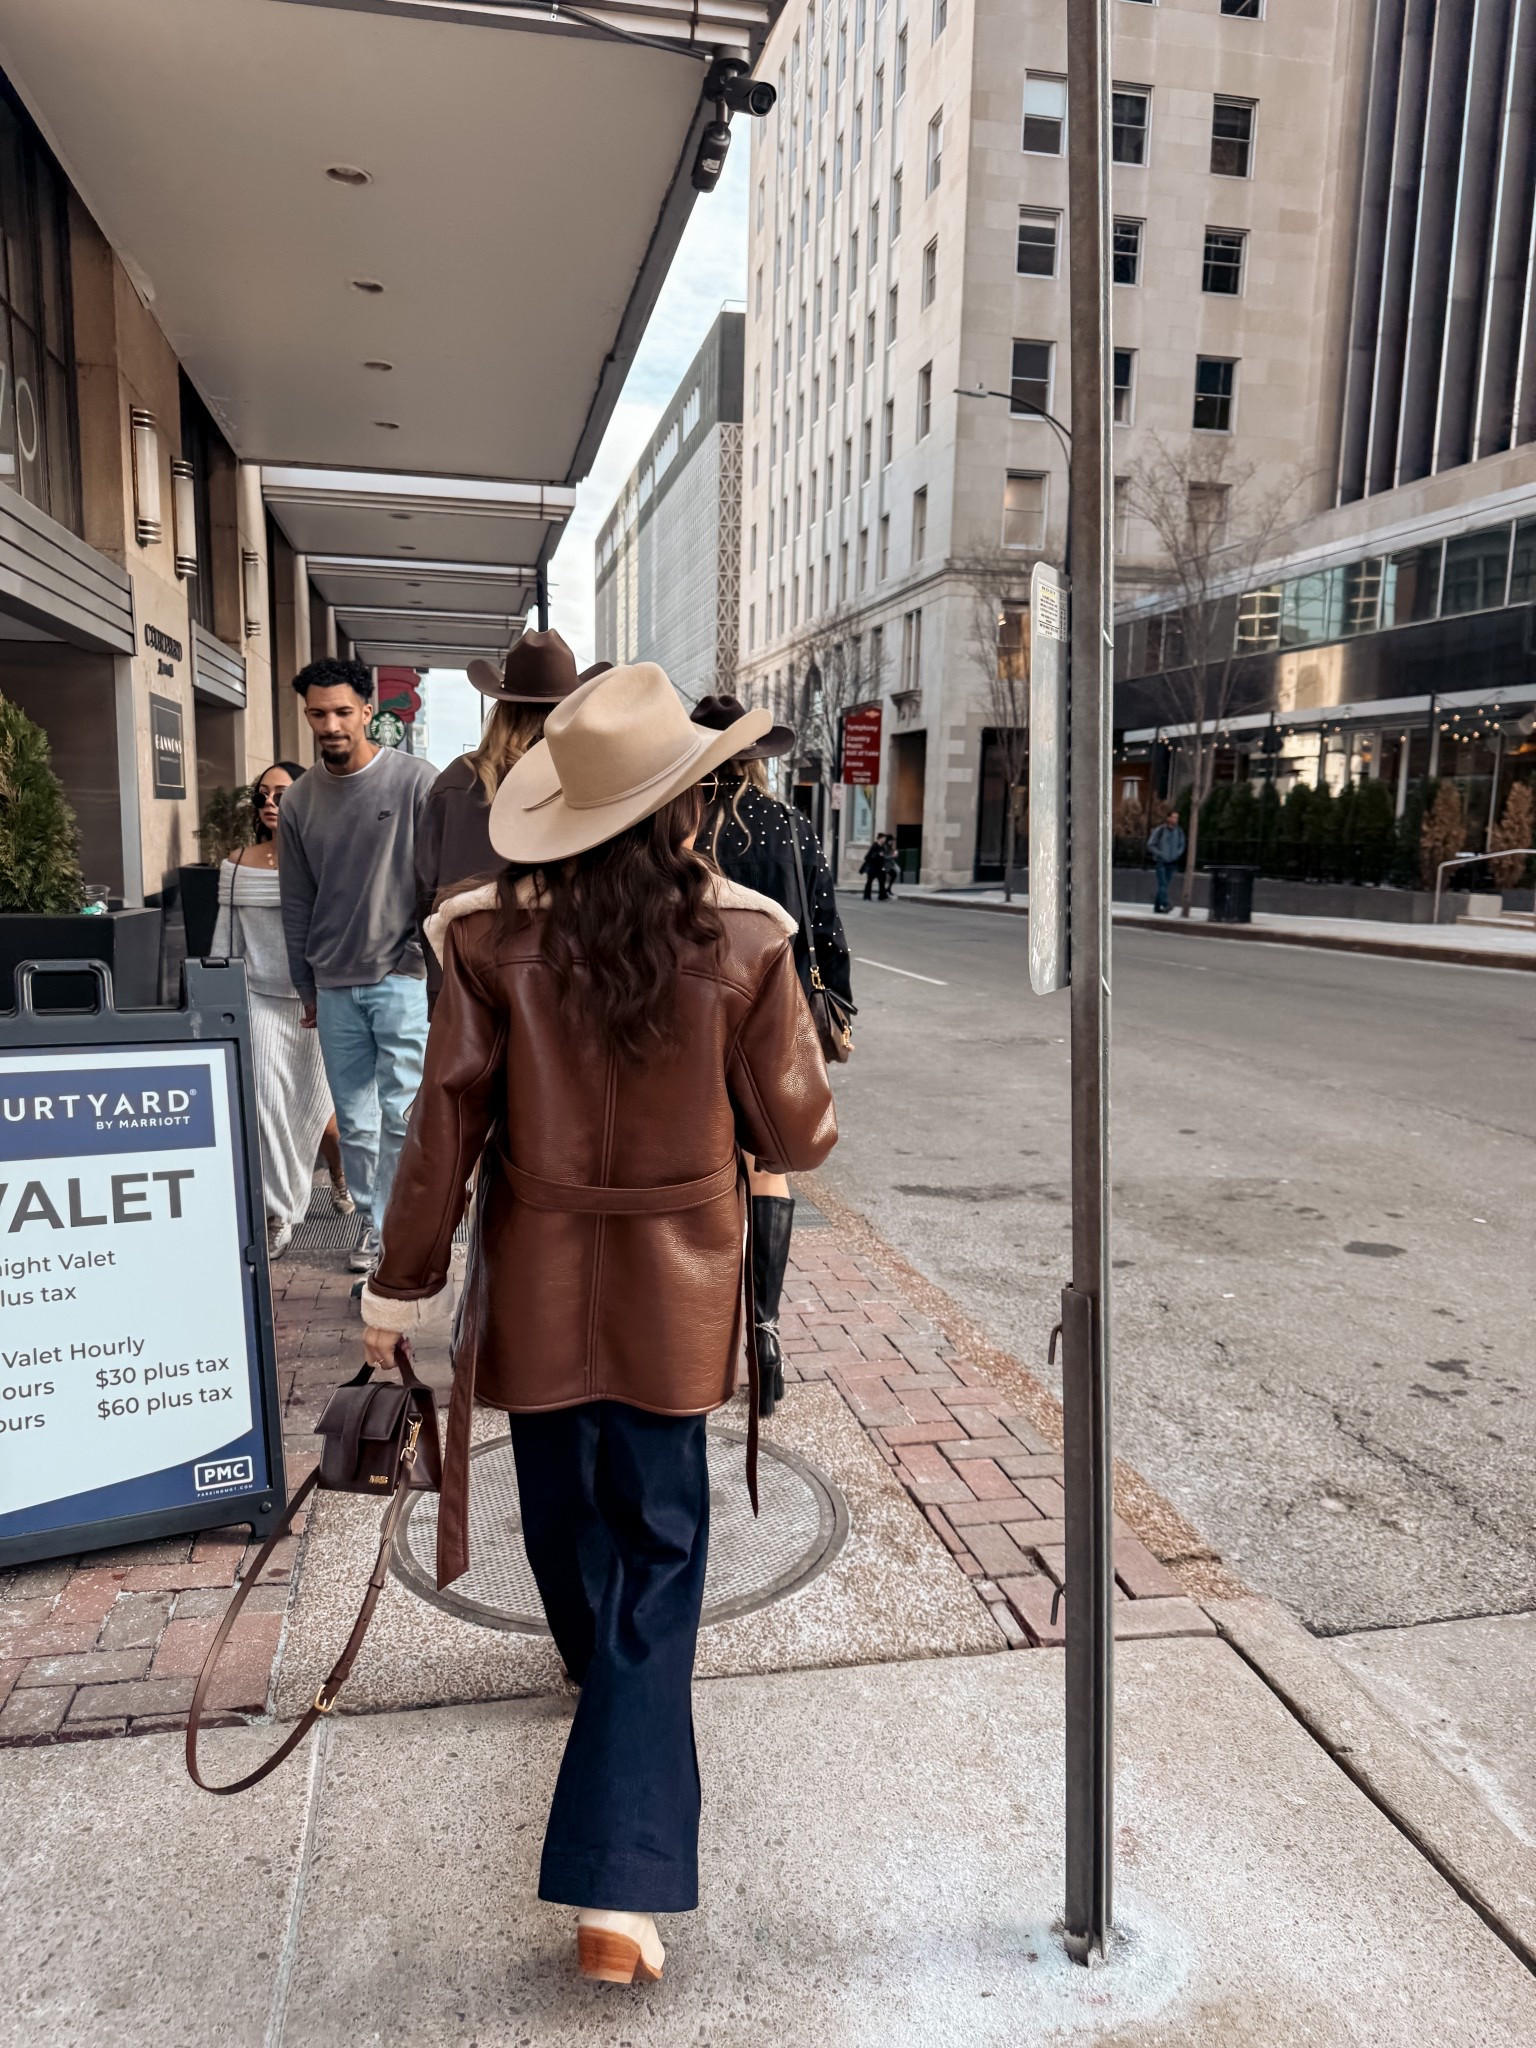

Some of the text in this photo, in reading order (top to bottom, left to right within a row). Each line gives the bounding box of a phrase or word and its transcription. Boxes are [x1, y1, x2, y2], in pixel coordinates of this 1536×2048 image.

[96, 1115, 190, 1130] BY MARRIOTT
[0, 1168, 195, 1234] ALET
[0, 1250, 117, 1279] ight Valet
[40, 1286, 77, 1303] tax
[2, 1336, 145, 1369] Valet Hourly
[2, 1357, 230, 1401] ours $30 plus tax
[97, 1397, 140, 1421] $60
[147, 1391, 193, 1416] plus
[199, 1386, 233, 1403] tax
[204, 1463, 246, 1484] PMC
